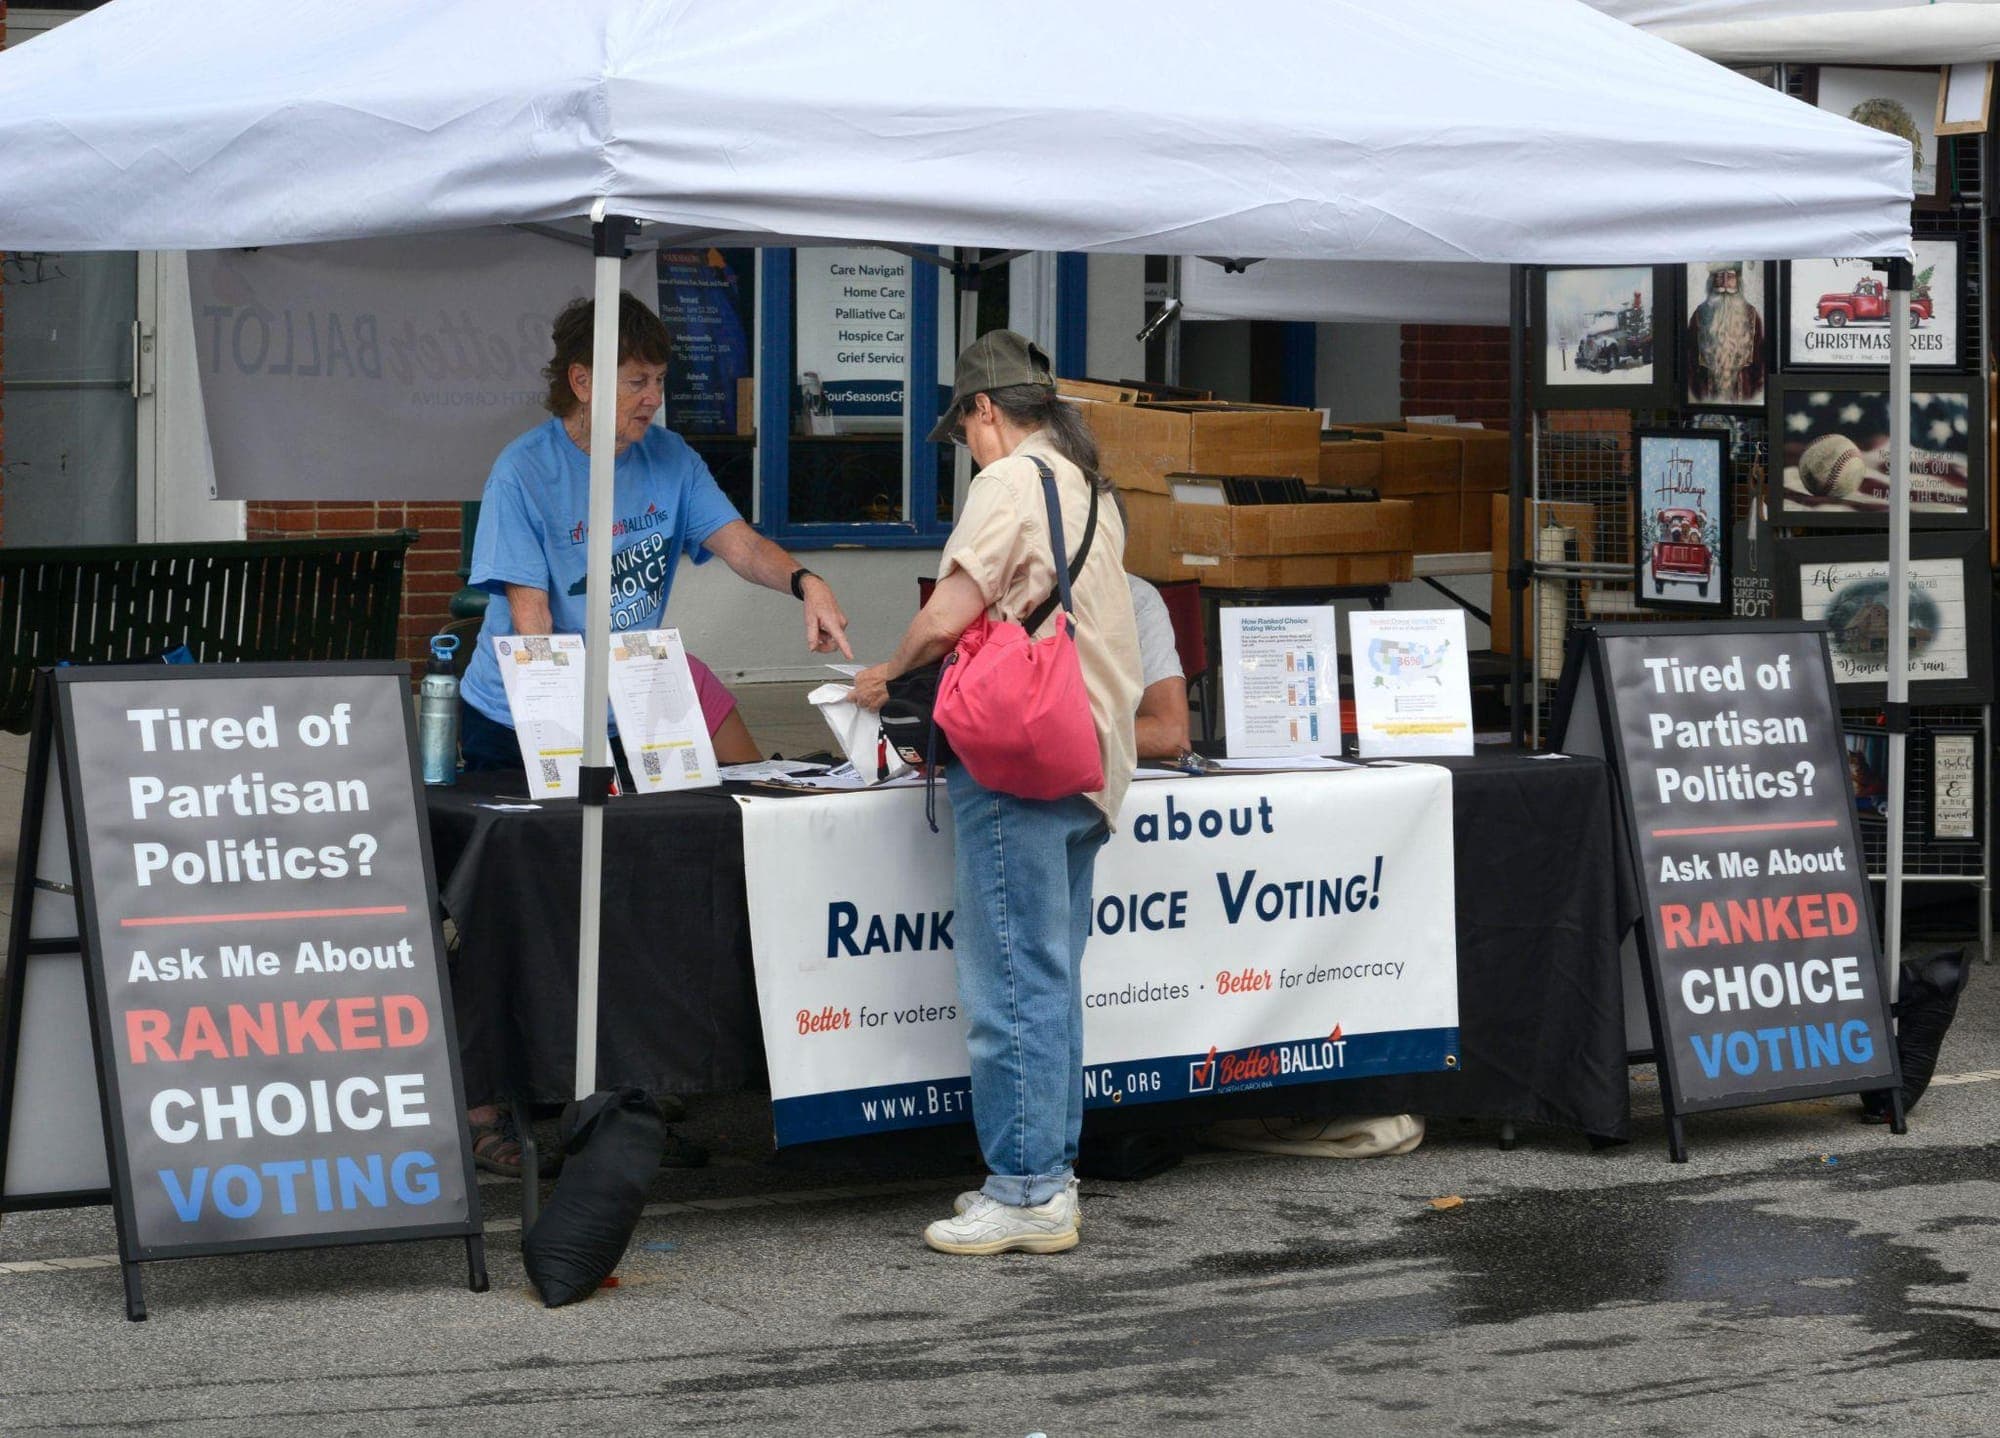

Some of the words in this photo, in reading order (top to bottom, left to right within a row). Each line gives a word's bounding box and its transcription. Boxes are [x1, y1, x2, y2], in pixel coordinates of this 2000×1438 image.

[830, 264, 855, 276] Care
[859, 265, 904, 279] Navigati
[844, 287, 877, 298] Home
[880, 287, 905, 298] Care
[835, 308, 886, 319] Palliative
[889, 309, 905, 320] Ca
[837, 352, 865, 364] Grief
[838, 330, 883, 344] Hospice
[886, 331, 904, 342] Car
[1805, 332, 1890, 350] CHRISTMAS
[1910, 334, 1943, 350] REES
[611, 533, 662, 577] NKED
[610, 555, 666, 606] HOICE
[1811, 565, 1839, 592] Life
[1257, 617, 1284, 625] Ranked
[1285, 617, 1308, 625] Choice
[1733, 599, 1770, 617] HOT
[1644, 656, 1744, 693] Tired
[1757, 654, 1792, 690] of
[127, 706, 279, 752] Tired
[298, 703, 351, 747] of
[1649, 710, 1808, 749] Partisan
[128, 773, 370, 819] Partisan
[1656, 761, 1816, 803] Politics?
[1946, 780, 1961, 798] &
[1134, 795, 1274, 843] about
[133, 833, 379, 886] Politics?
[1660, 855, 1712, 883] Ask
[1719, 851, 1760, 879] Me
[1768, 846, 1846, 876] About
[827, 901, 954, 958] RANK
[1088, 891, 1187, 936] OICE
[1660, 892, 1858, 949] RANKED
[127, 947, 205, 983] Ask
[221, 944, 280, 977] Me
[295, 936, 415, 974] About
[796, 1006, 852, 1035] Better
[860, 1006, 888, 1028] for
[894, 1004, 957, 1025] voters
[1085, 982, 1189, 1008] candidates
[1216, 967, 1272, 995] Better
[1279, 969, 1303, 990] for
[1306, 959, 1405, 986] democracy
[1681, 957, 1864, 1014] CHOICE
[125, 994, 429, 1064] RANKED
[1691, 1019, 1874, 1079] VOTING
[149, 1074, 431, 1144] CHOICE
[159, 1150, 441, 1222] VOTING
